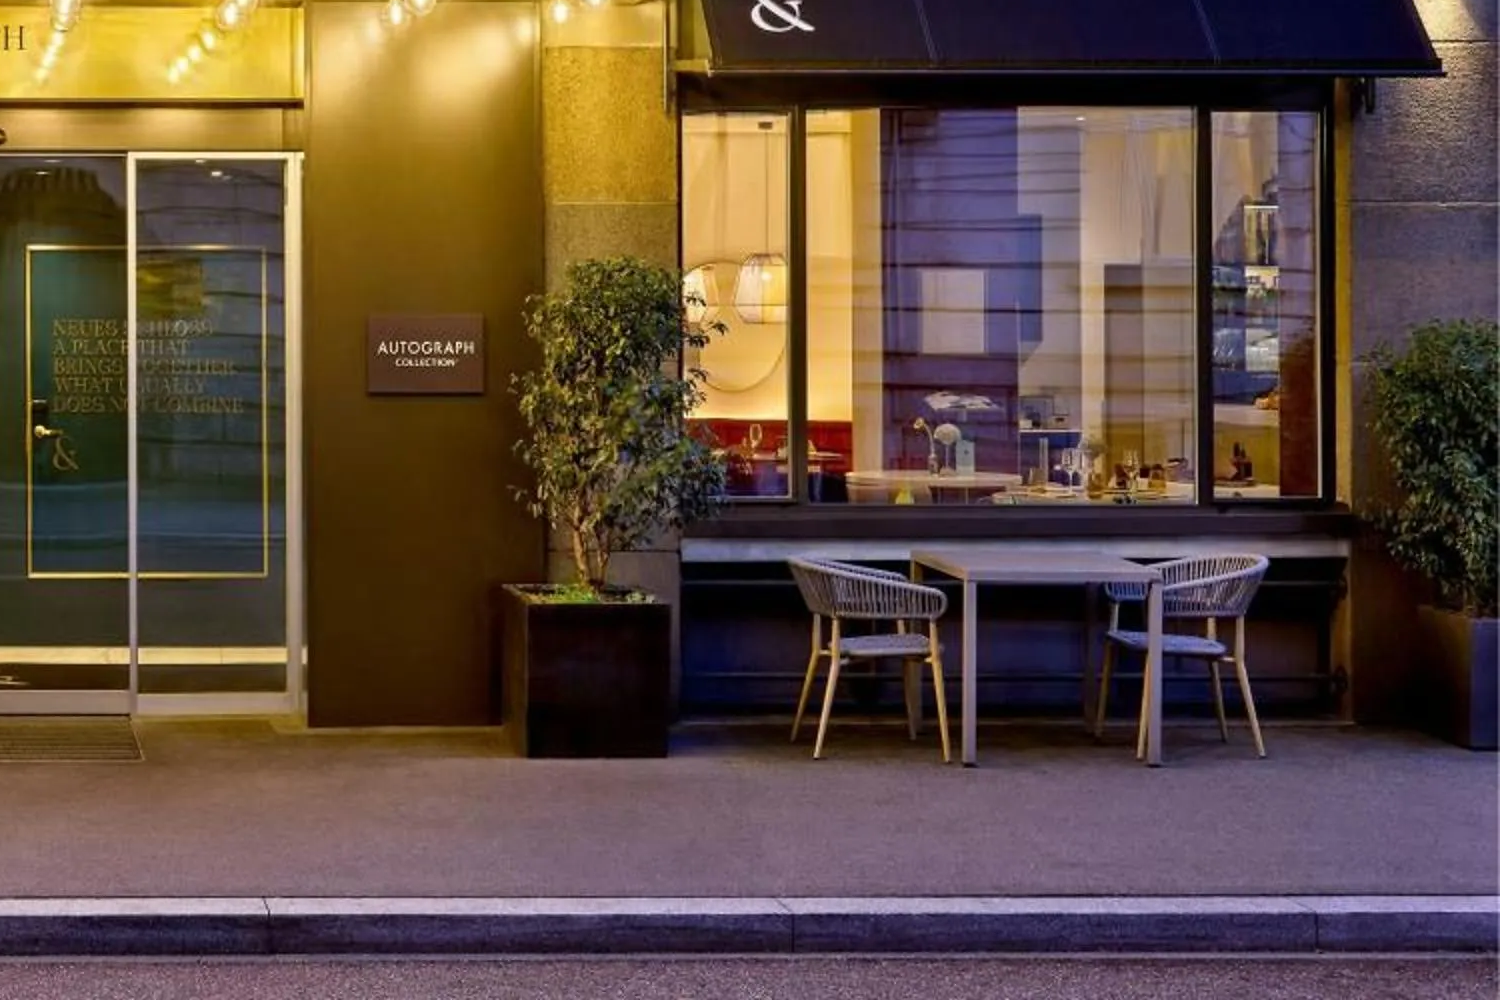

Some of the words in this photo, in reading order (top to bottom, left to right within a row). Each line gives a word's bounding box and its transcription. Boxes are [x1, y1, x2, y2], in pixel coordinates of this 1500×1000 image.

[52, 319, 119, 337] NEUES
[53, 339, 66, 355] A
[377, 341, 475, 355] AUTOGRAPH
[54, 357, 124, 375] BRINGS
[132, 358, 238, 375] OGETHER
[395, 358, 455, 367] COLLECTION
[54, 377, 113, 394] WHAT
[53, 396, 105, 413] DOES
[52, 435, 79, 471] &
